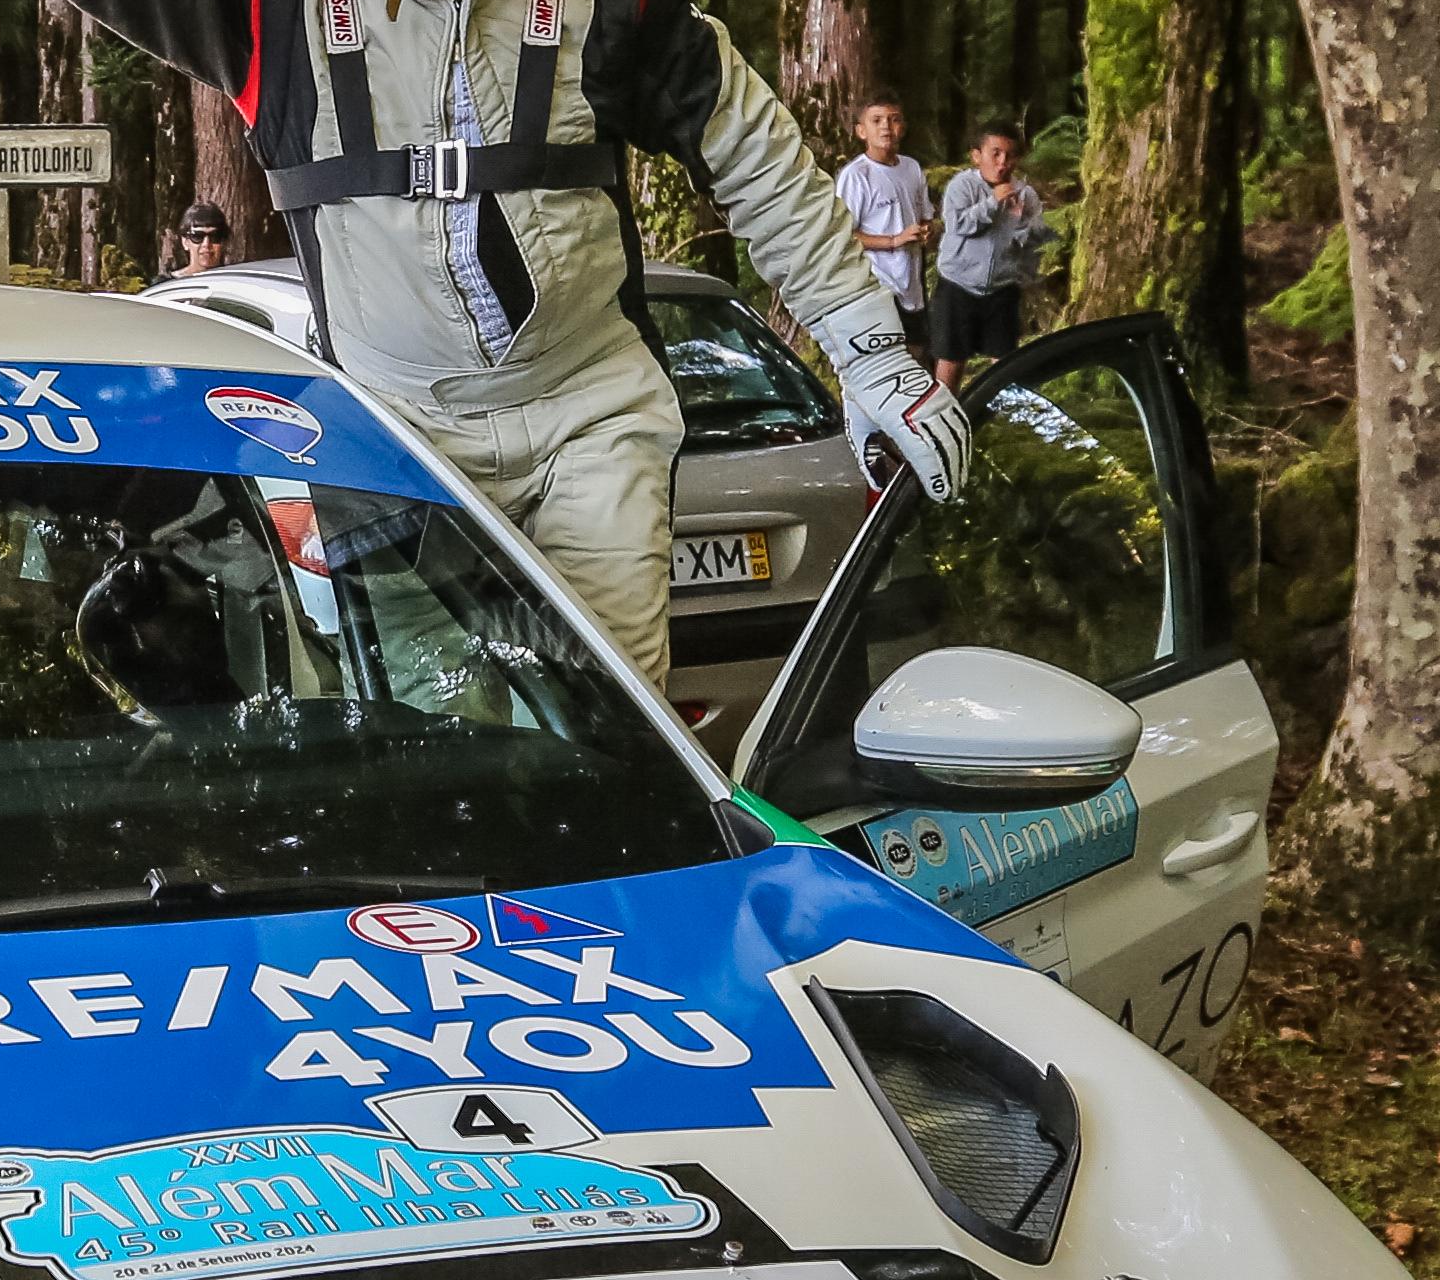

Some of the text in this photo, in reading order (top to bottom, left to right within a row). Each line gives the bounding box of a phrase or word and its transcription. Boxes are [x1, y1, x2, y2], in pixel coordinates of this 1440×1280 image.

[221, 402, 304, 422] RE/MAX
[265, 1011, 753, 1087] 4YOU
[455, 1094, 534, 1146] 4
[61, 1170, 321, 1237] Além
[316, 1147, 521, 1202] Mar
[212, 1208, 339, 1246] Rali
[361, 1200, 486, 1227] Ilha
[501, 1184, 650, 1213] Lilás
[115, 1269, 135, 1278] 20
[154, 1262, 172, 1273] 21
[177, 1259, 196, 1270] de
[198, 1250, 271, 1266] Setembro
[275, 1244, 316, 1257] 2024
